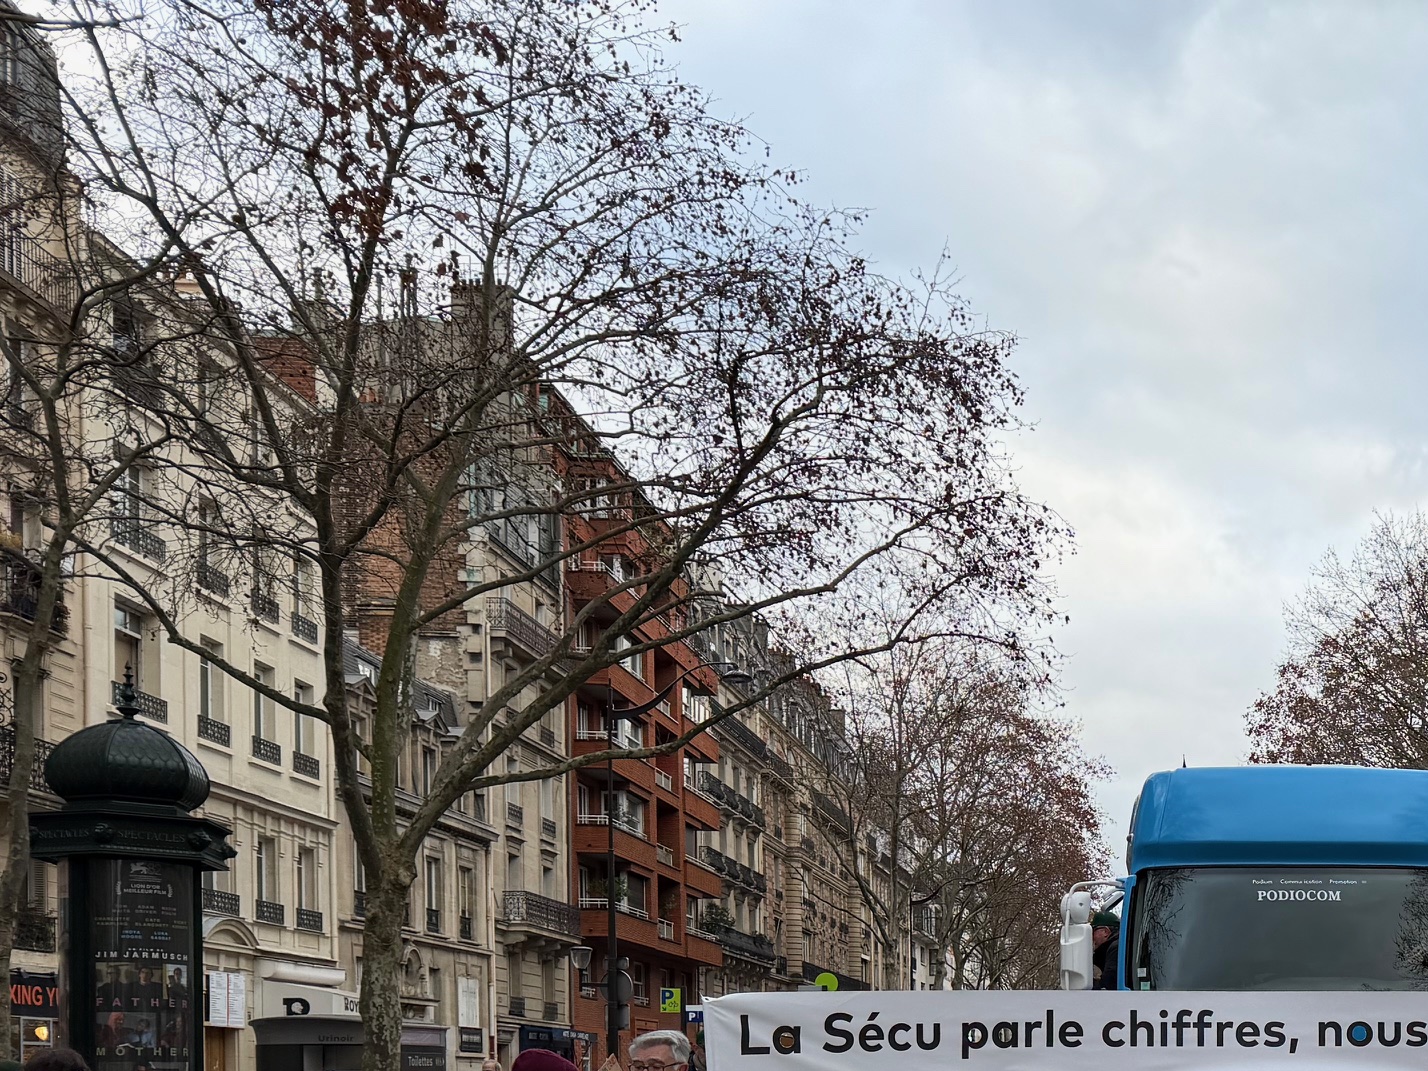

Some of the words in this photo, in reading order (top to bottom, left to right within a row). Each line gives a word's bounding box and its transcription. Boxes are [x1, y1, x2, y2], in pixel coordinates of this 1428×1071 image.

[39, 830, 90, 839] SPECTACLES
[118, 830, 186, 843] SPECTACLES
[1257, 889, 1342, 902] PODIOCOM
[123, 951, 188, 961] JARMUSCH
[96, 997, 188, 1009] FATHER
[661, 990, 674, 1004] P
[344, 997, 360, 1013] ROY
[318, 1034, 355, 1042] Urinoir
[740, 1014, 802, 1056] La
[822, 1011, 942, 1054] Sécu
[961, 1009, 1085, 1060] parle
[1101, 1009, 1300, 1054] chiffres,
[1317, 1020, 1428, 1048] nous
[96, 1047, 190, 1057] MOTHER
[408, 1055, 434, 1067] Toilettes
